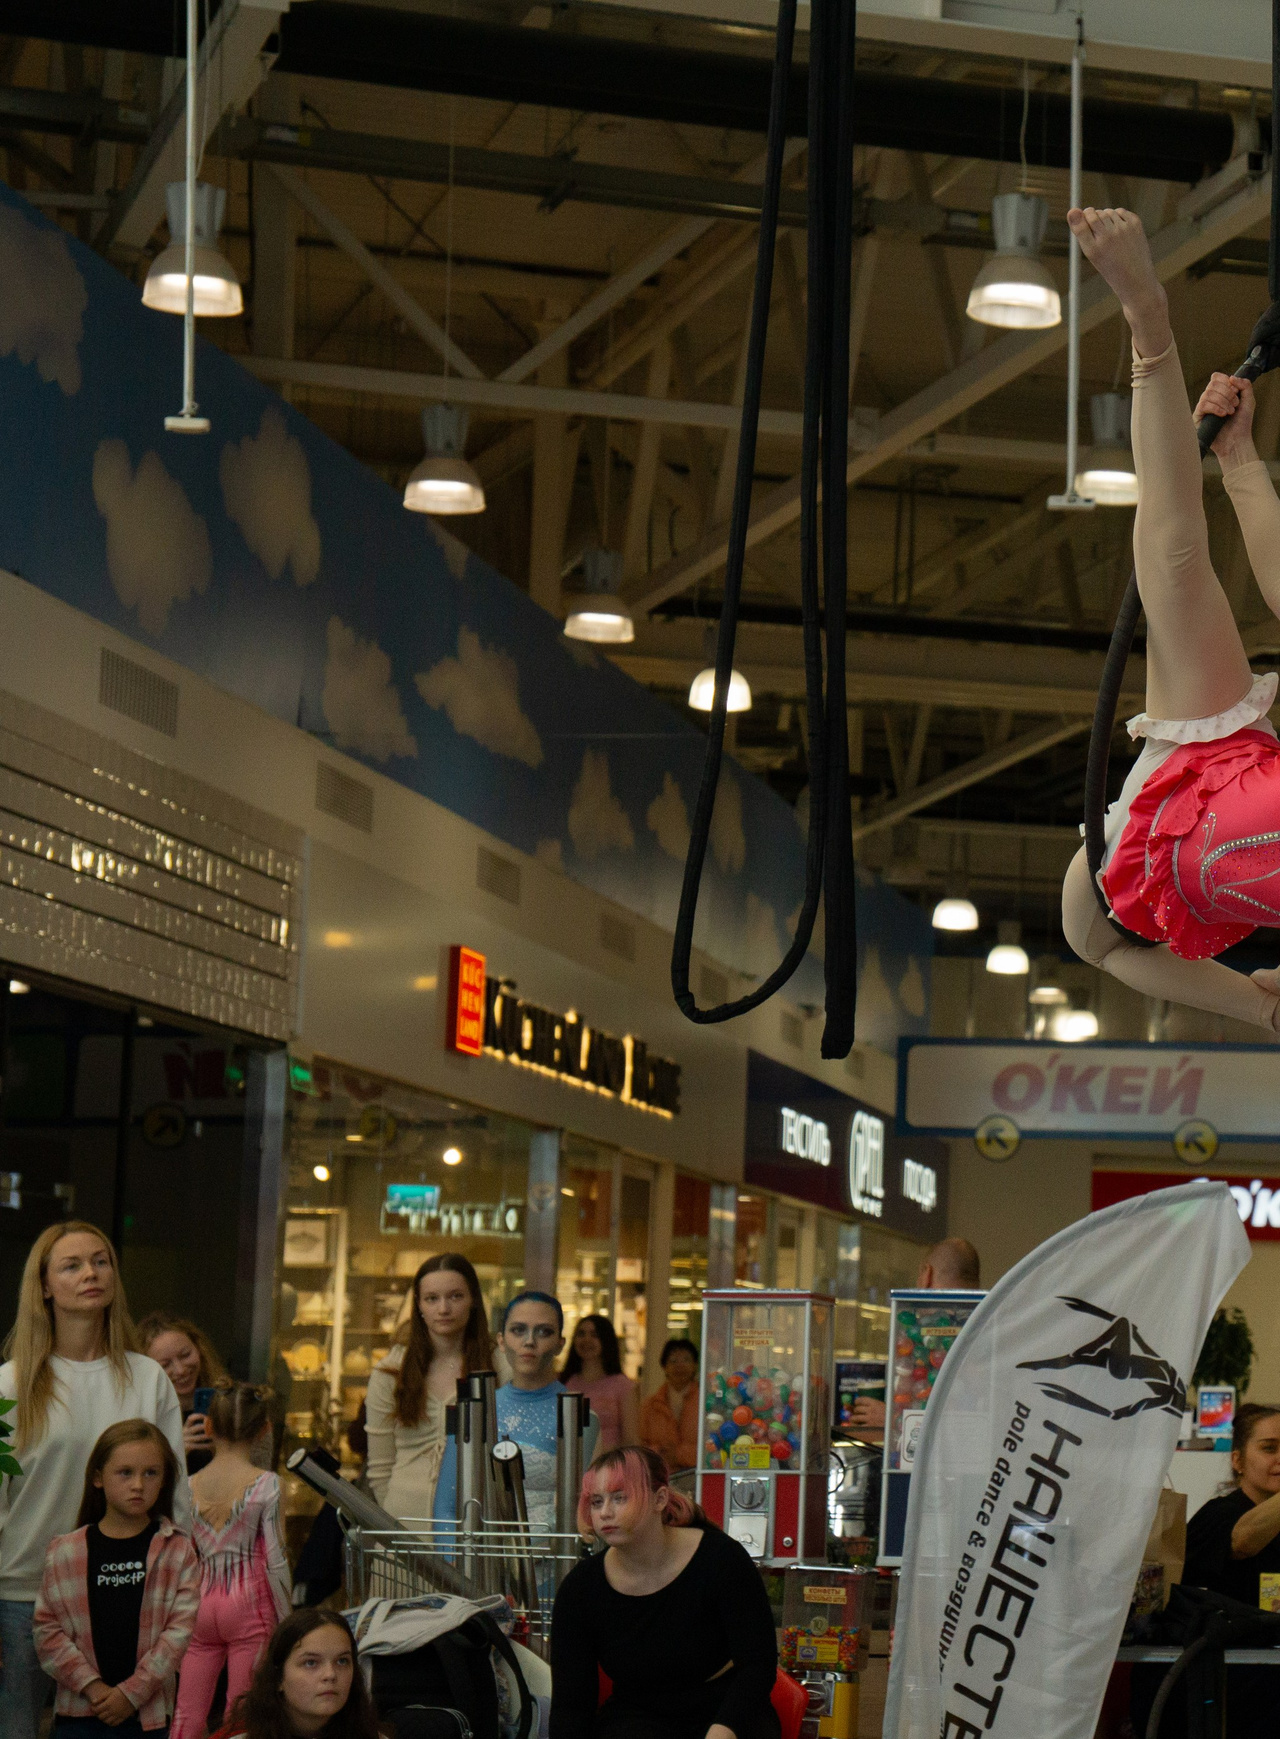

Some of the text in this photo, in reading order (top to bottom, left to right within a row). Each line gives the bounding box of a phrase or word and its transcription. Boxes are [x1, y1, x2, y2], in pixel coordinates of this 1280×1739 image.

[781, 1107, 831, 1166] ТЕКСТИЛЬ
[1003, 1401, 1031, 1453] pole
[976, 1457, 1011, 1526] dance
